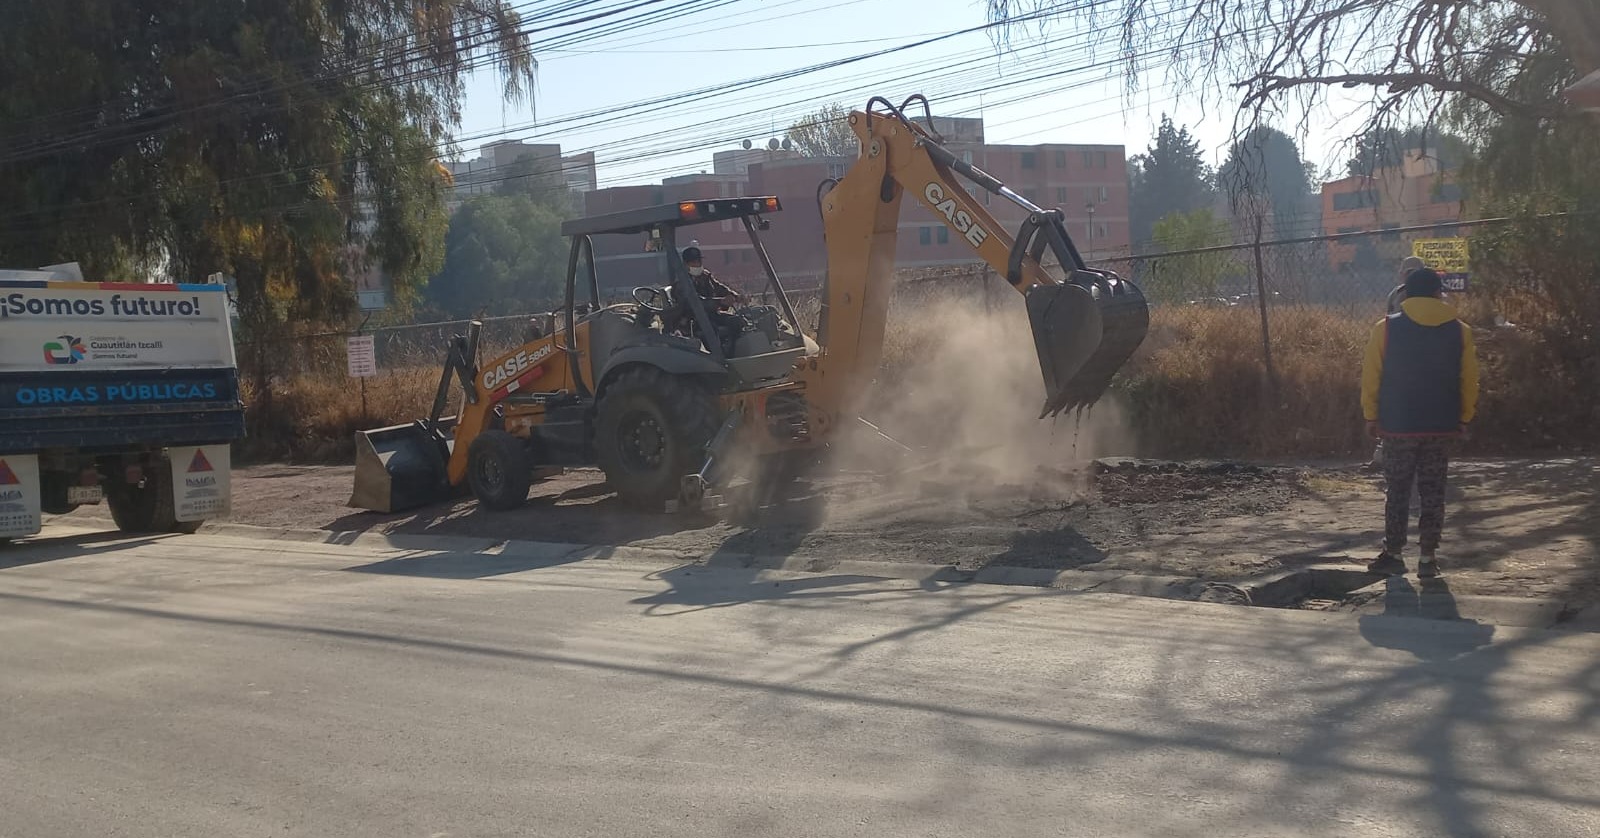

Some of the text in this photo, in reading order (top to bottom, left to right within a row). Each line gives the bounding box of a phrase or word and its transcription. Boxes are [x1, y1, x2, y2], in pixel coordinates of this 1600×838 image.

[925, 182, 988, 248] CASE
[0, 293, 202, 318] ¡Somos futuro!
[483, 350, 528, 390] CASE
[15, 381, 217, 405] OBRAS PÚBLICAS
